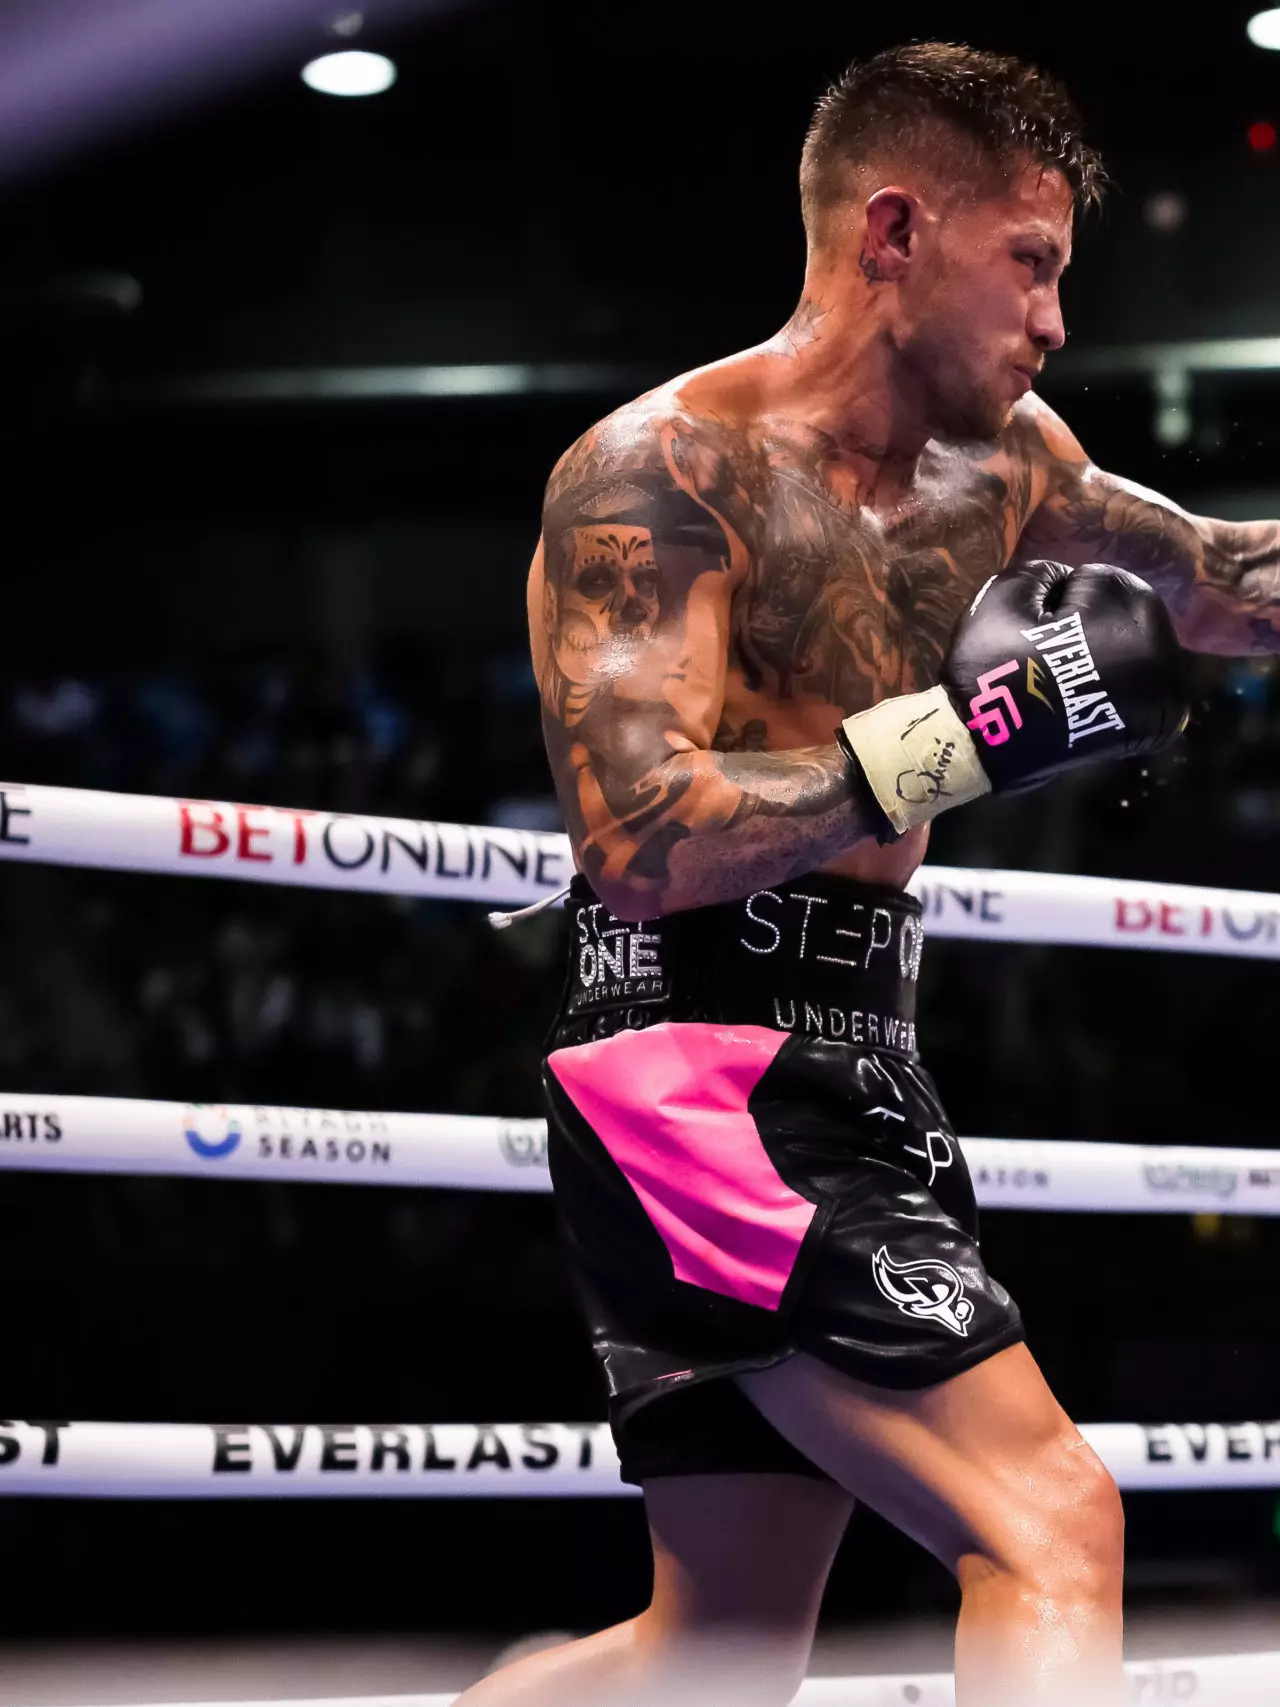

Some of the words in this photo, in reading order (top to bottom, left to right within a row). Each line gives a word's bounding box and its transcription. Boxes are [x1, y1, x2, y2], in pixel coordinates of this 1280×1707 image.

[1020, 611, 1126, 746] EVERLAST
[179, 799, 564, 888] BETONLINE
[579, 933, 663, 988] ONE
[576, 980, 664, 1006] UNDERWEAR
[258, 1134, 392, 1165] SEASON
[207, 1422, 602, 1474] EVERLAST
